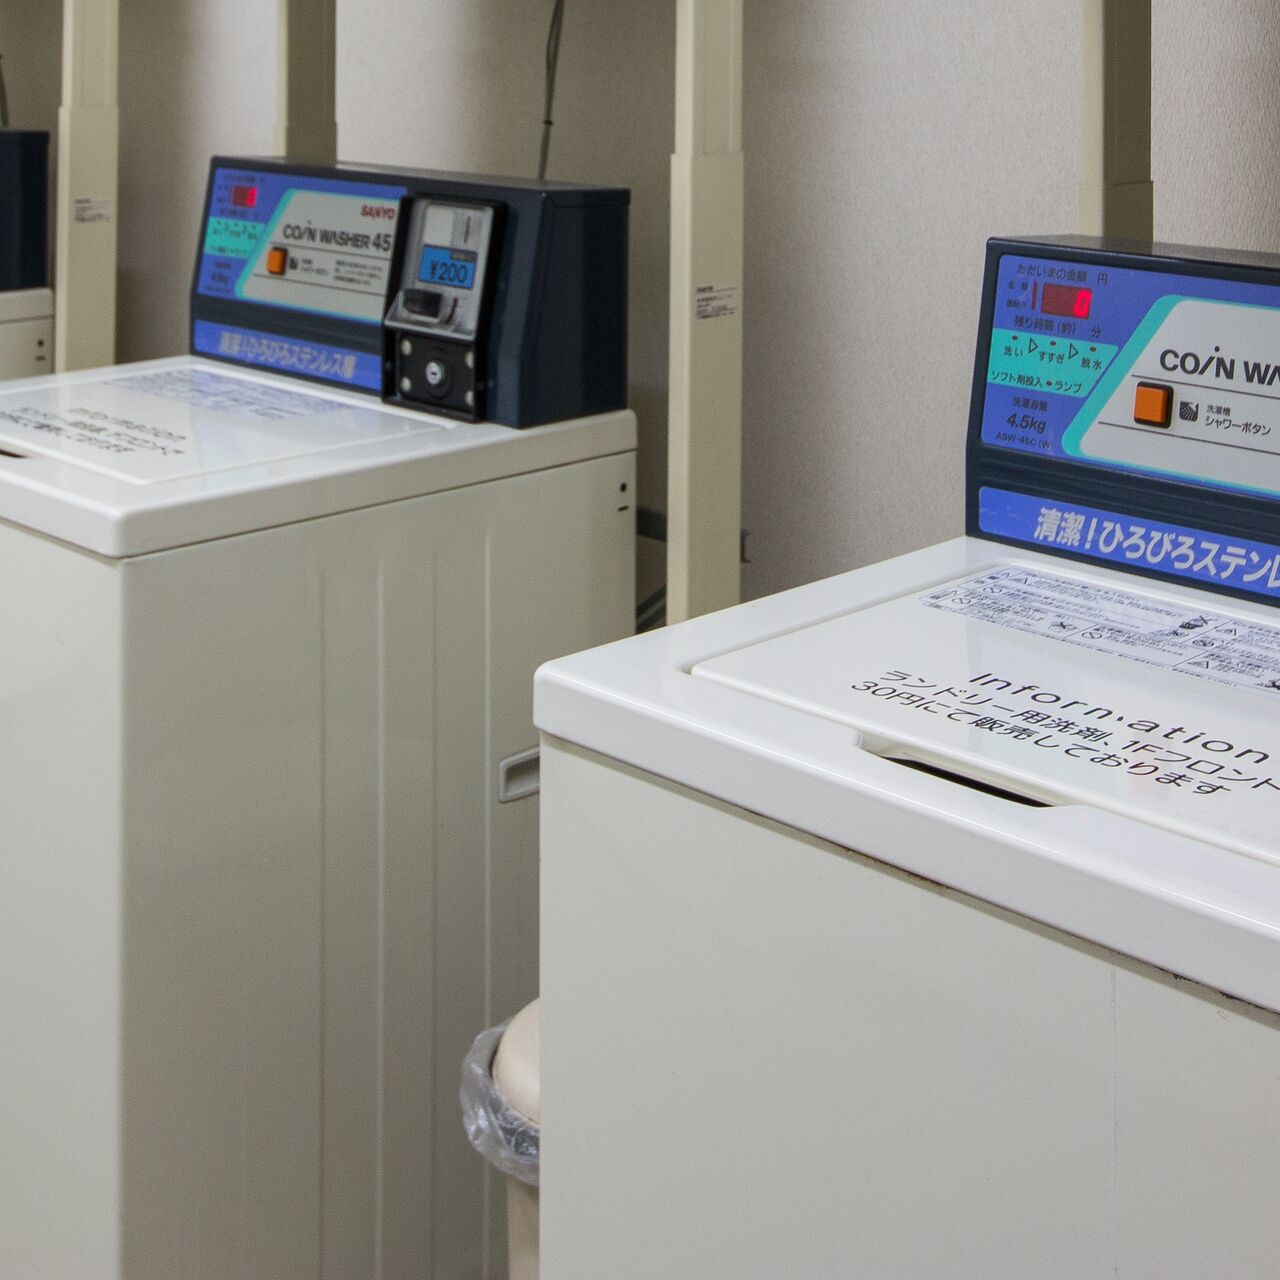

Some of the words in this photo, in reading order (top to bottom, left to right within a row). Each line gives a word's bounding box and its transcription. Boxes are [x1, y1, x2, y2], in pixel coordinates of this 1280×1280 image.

[320, 228, 369, 249] WASHER
[371, 232, 392, 252] 45
[430, 259, 468, 284] ¥200
[1017, 264, 1087, 282] ただいまの金額
[1097, 274, 1108, 286] 円
[1074, 290, 1092, 318] 0
[1091, 326, 1101, 338] 分
[1003, 345, 1023, 357] 洗い
[1038, 351, 1065, 364] すすぎ
[1081, 357, 1102, 370] 脱水
[1160, 346, 1235, 380] COIN
[1055, 381, 1082, 393] ランプ
[1206, 404, 1231, 417] 洗濯槽
[1007, 412, 1046, 434] 4.5kg
[1205, 416, 1271, 436] シャワーボタン
[851, 680, 1231, 797] 30円にて販売しております
